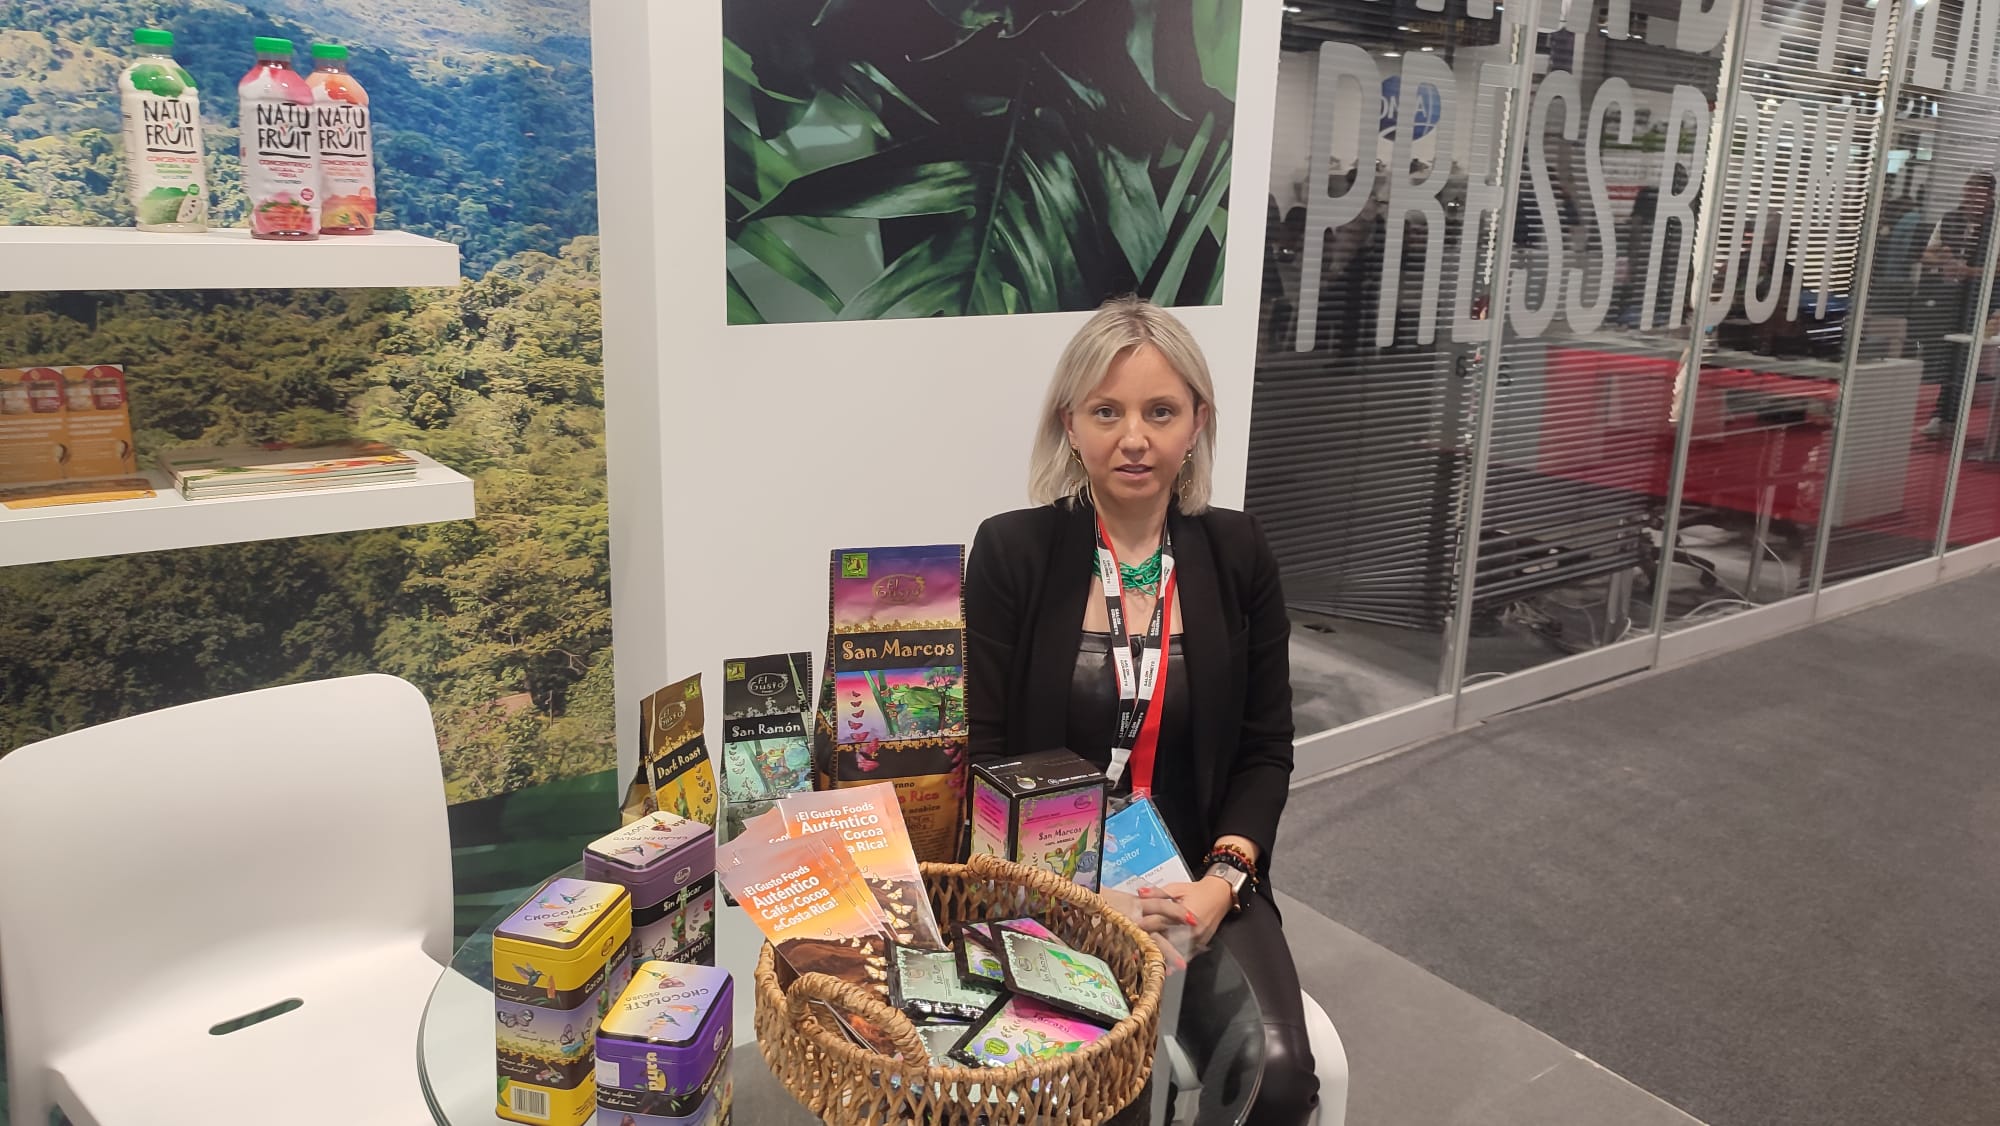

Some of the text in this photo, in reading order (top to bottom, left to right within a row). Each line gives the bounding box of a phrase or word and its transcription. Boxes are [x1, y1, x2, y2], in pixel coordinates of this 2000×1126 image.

[143, 99, 191, 124] NATU
[257, 102, 310, 129] NATU
[317, 105, 366, 129] NATU
[145, 123, 194, 148] FRUIT
[258, 128, 312, 152] FRUIT
[319, 129, 368, 151] FRUIT
[1296, 40, 1858, 353] PRESS ROOM
[842, 638, 955, 660] San Marcos
[750, 681, 784, 691] Gusto
[732, 721, 801, 738] San Ramón
[656, 746, 702, 780] Dark Roast
[795, 801, 875, 822] ¡El Gusto Foods
[801, 814, 879, 835] Auténtico
[843, 827, 884, 841] Cocoa
[1038, 827, 1082, 841] San Marcos
[856, 837, 889, 852] Rica!
[743, 865, 811, 898] ¡El Gusto Foods
[752, 876, 820, 909] Auténtico
[663, 900, 675, 911] Sin
[761, 888, 830, 920] Café y Cocoa
[809, 897, 839, 916] Rica!
[623, 988, 709, 1011] CHOCOLATE
